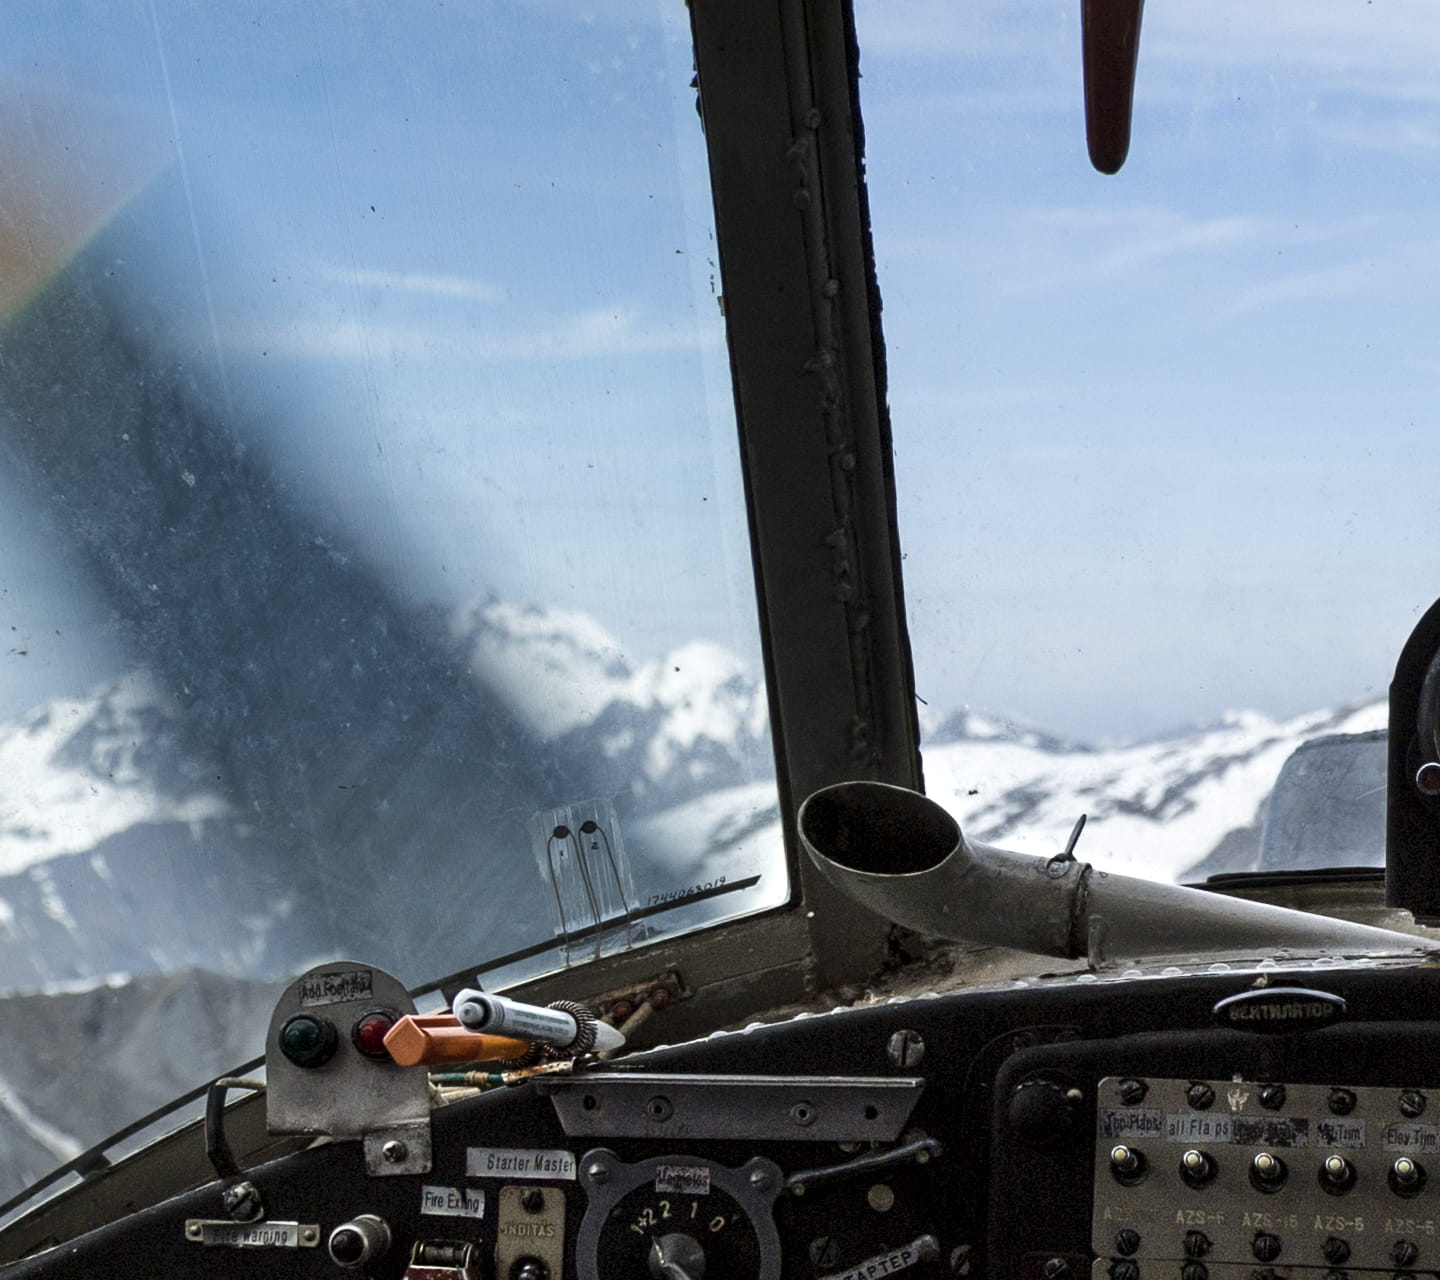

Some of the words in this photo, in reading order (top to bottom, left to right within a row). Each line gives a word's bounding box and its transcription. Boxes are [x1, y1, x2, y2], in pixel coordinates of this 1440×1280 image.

[487, 1153, 531, 1172] Starter
[535, 1156, 575, 1174] Master
[424, 1191, 446, 1209] Fire
